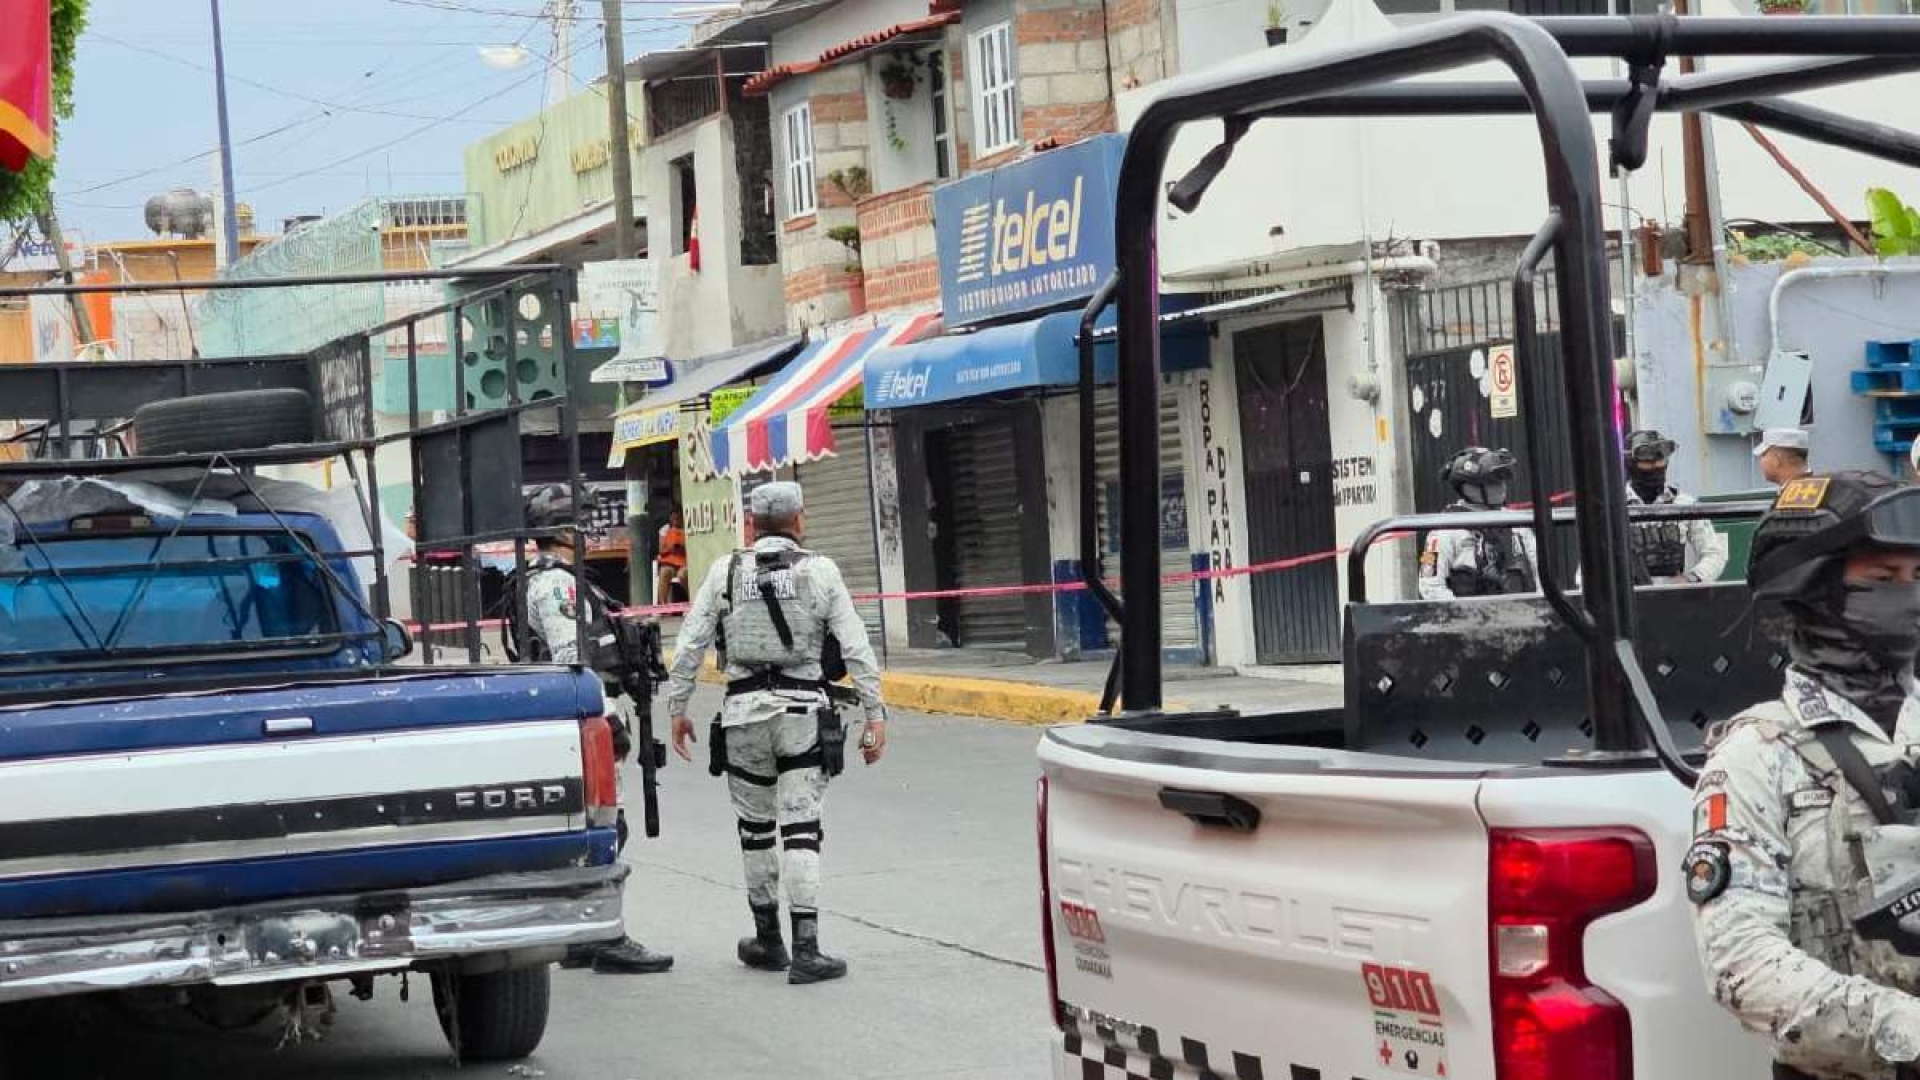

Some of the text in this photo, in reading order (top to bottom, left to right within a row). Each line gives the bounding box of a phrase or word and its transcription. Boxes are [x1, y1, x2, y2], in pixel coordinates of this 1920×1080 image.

[991, 175, 1083, 277] telcel
[890, 364, 932, 399] telcel
[1200, 379, 1215, 474] ROPA
[455, 785, 566, 808] FORD
[1057, 857, 1432, 960] CHEVROLET
[1367, 971, 1431, 1009] 911
[1375, 1020, 1445, 1047] EMERGENCIAS
